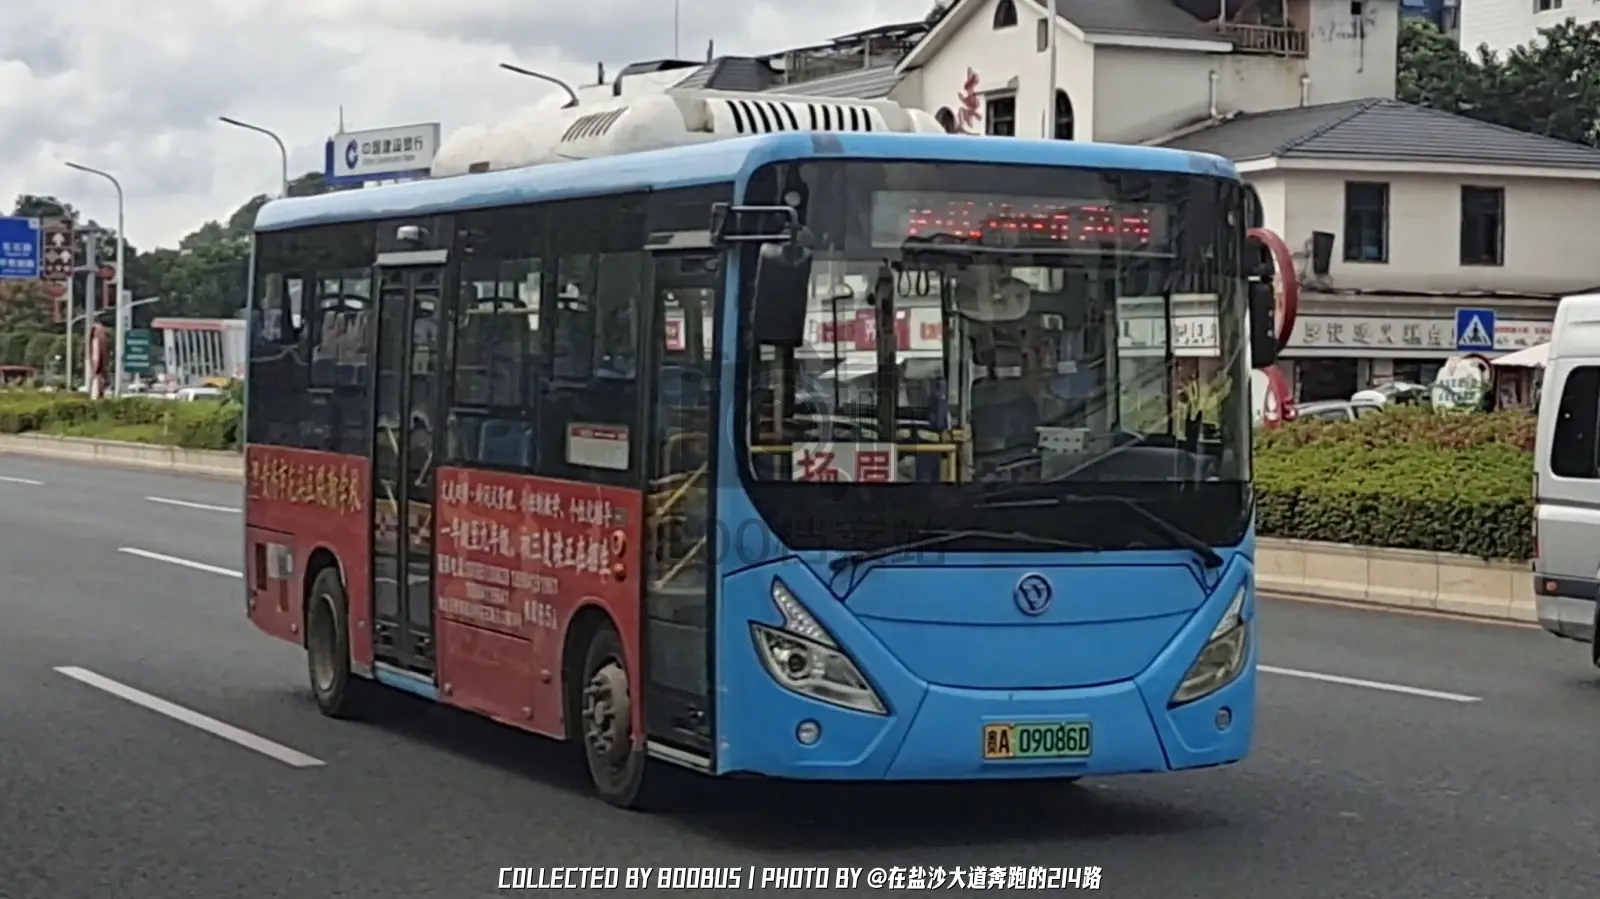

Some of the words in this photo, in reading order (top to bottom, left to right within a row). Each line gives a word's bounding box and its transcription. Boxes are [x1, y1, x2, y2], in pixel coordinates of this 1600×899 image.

[362, 135, 423, 155] 中国建设银行
